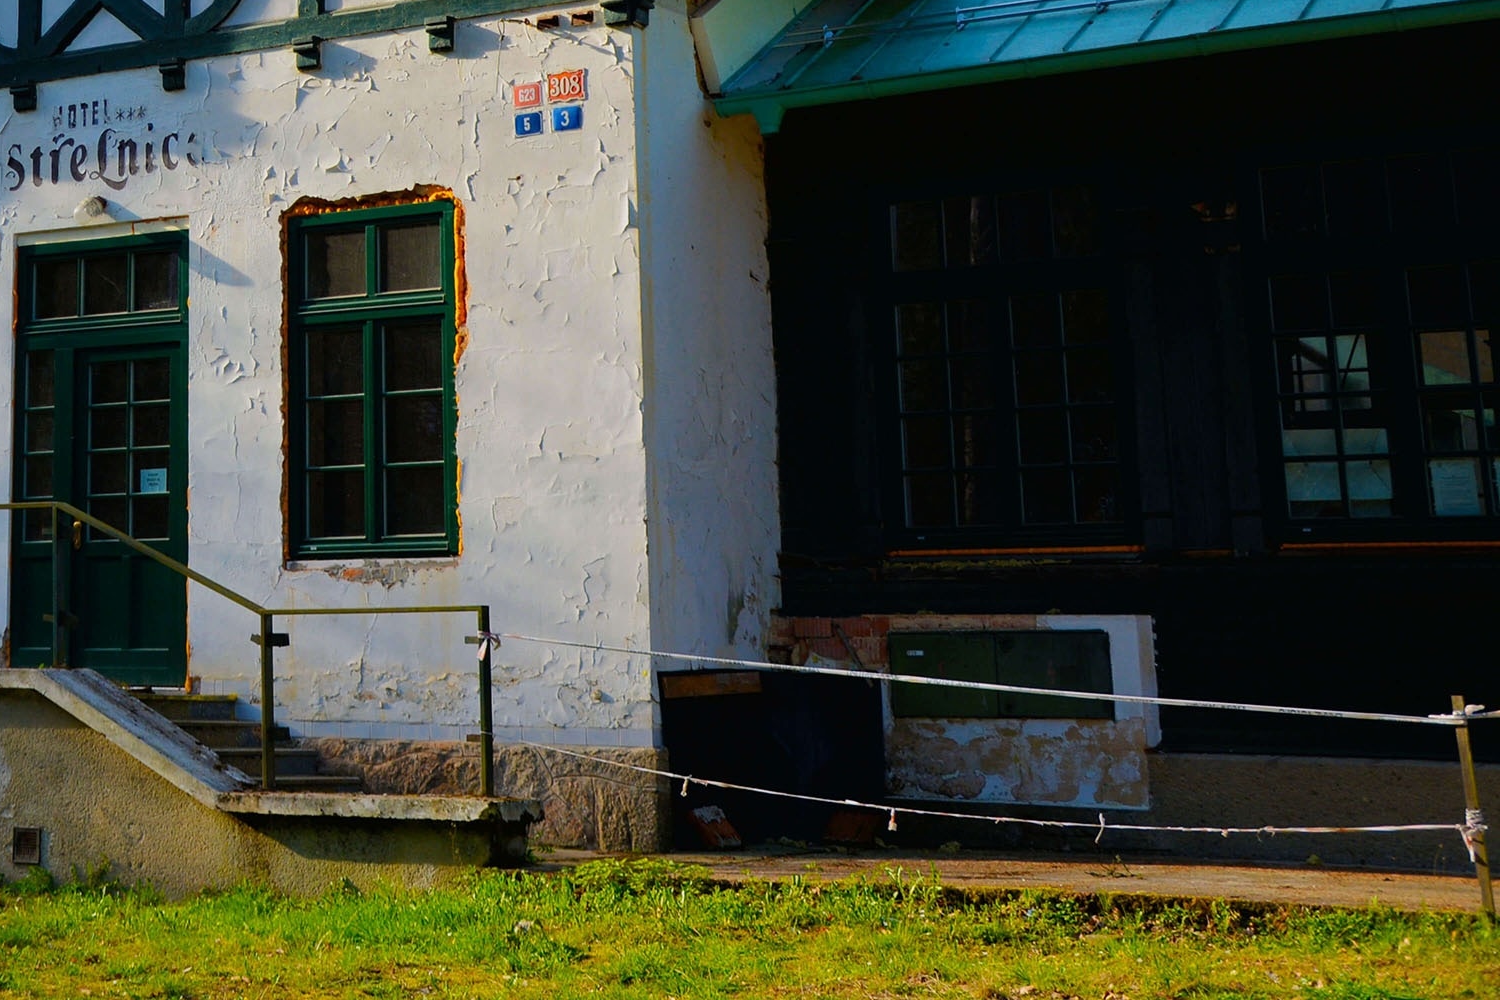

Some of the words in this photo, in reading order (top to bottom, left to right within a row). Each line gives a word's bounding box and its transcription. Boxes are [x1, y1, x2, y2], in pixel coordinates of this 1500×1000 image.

[551, 75, 580, 97] 308
[519, 88, 535, 102] 623
[53, 99, 111, 128] HOTEL
[561, 111, 569, 126] 3
[524, 118, 531, 132] 5
